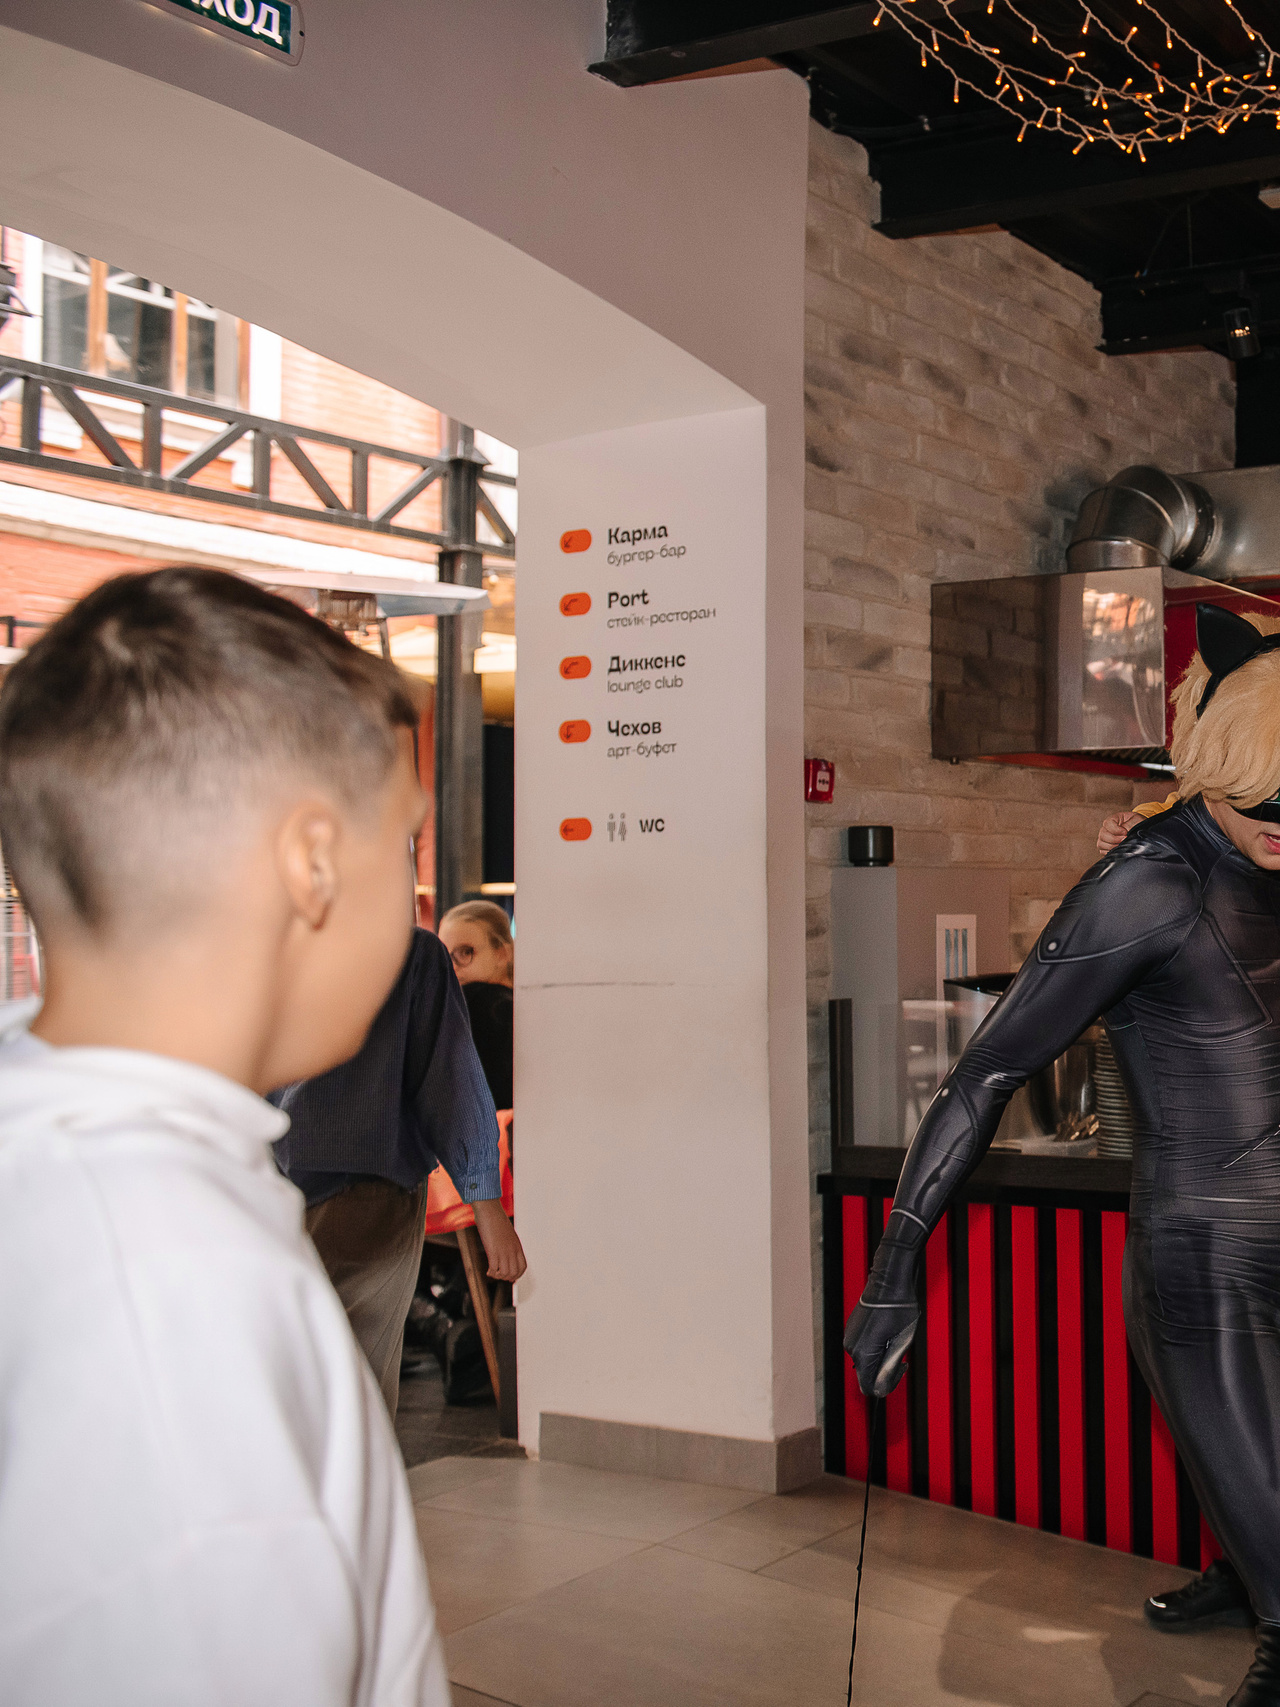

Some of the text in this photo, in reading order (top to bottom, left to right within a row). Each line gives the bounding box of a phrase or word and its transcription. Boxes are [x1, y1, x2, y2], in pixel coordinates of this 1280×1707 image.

[607, 525, 669, 545] Карма
[606, 544, 687, 567] бургер-бар
[607, 589, 649, 609] Port
[606, 608, 717, 629] стейк-ресторан
[607, 654, 687, 676] Диккенс
[607, 675, 684, 694] lounge club
[607, 720, 662, 737] Чехов
[606, 741, 677, 760] арт-буфет
[639, 818, 665, 833] WC
